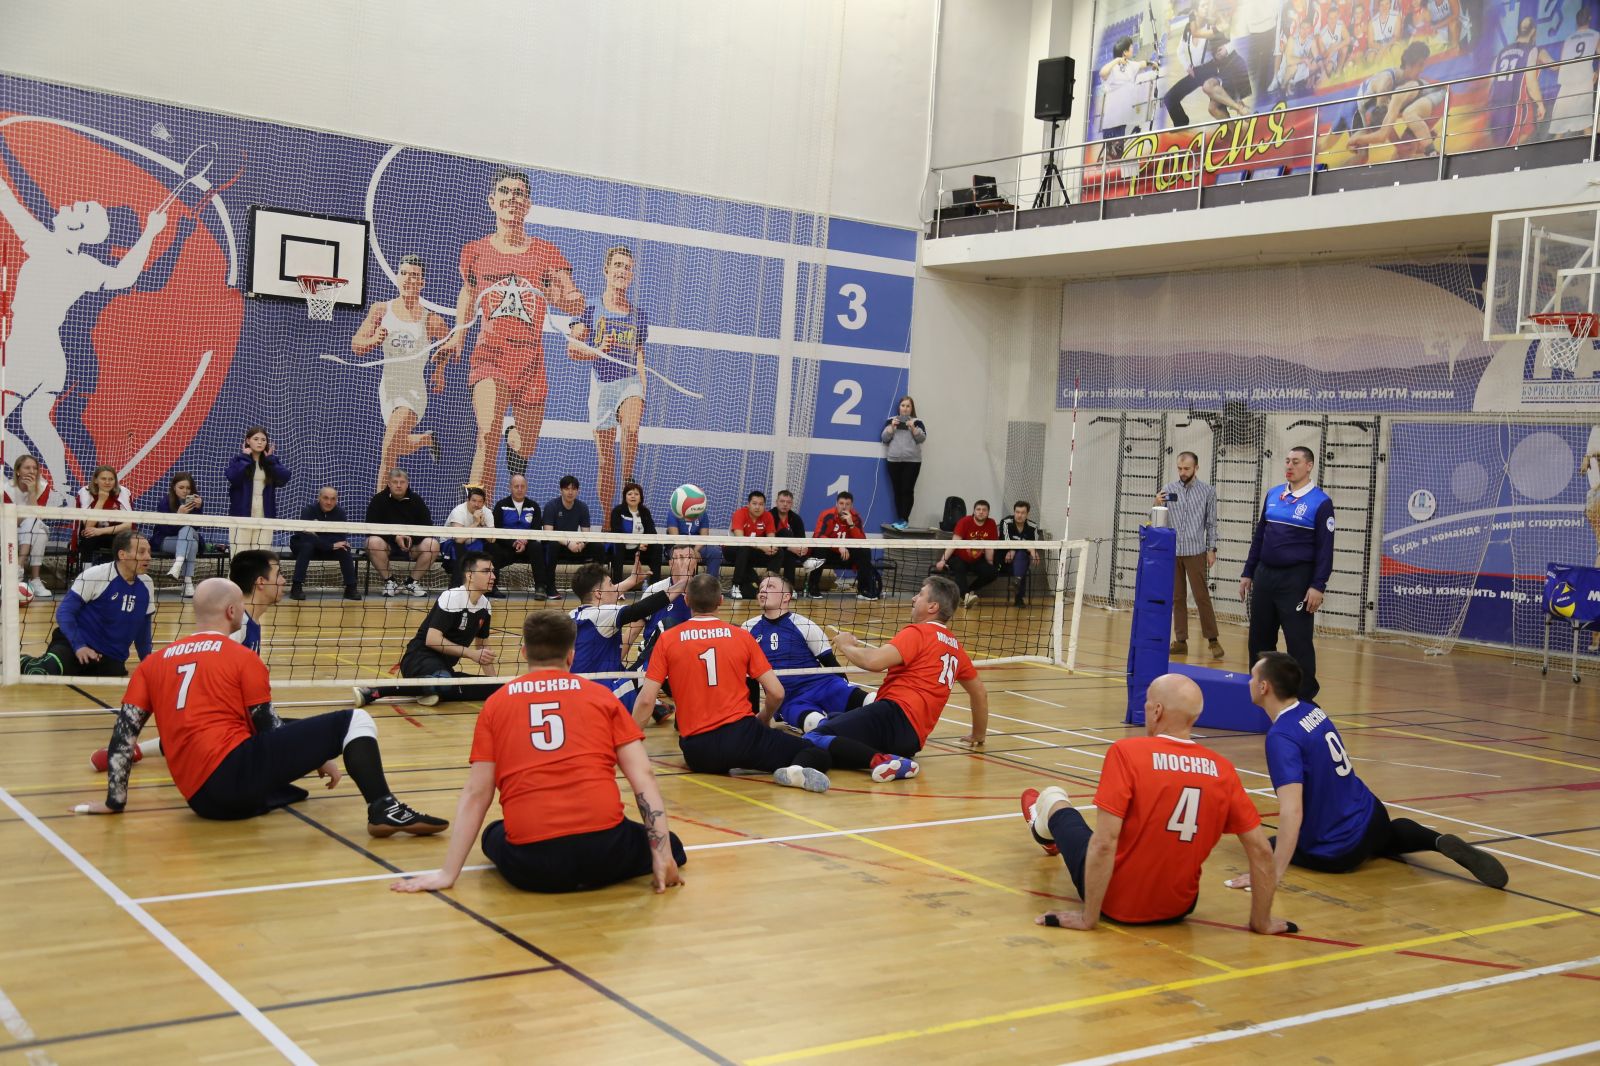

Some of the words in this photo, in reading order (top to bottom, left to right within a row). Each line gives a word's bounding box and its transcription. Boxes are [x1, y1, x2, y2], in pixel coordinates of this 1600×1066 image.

[1575, 42, 1586, 57] 9
[1497, 58, 1519, 81] 21
[1121, 101, 1294, 196] Россия
[837, 283, 868, 330] 3
[830, 379, 863, 426] 2
[1316, 390, 1336, 399] это
[1339, 388, 1368, 399] твой
[1371, 387, 1409, 399] РИТМ
[1410, 389, 1455, 399] жизни
[1392, 541, 1420, 554] Будь
[1431, 525, 1481, 543] команде
[1491, 520, 1525, 530] живи
[1528, 517, 1585, 529] спортом!
[1392, 584, 1433, 596] Чтобы
[1436, 585, 1497, 599] изменить
[1500, 589, 1530, 604] мир,
[163, 640, 223, 659] МОСКВА
[680, 628, 732, 642] МОСКВА
[698, 647, 718, 687] 1
[938, 653, 959, 690] 10
[176, 662, 197, 711] 7
[508, 678, 582, 696] МОСКВА
[529, 701, 566, 752] 5
[1152, 752, 1220, 778] МОСКВА
[1325, 731, 1352, 777] 9
[1166, 786, 1202, 842] 4
